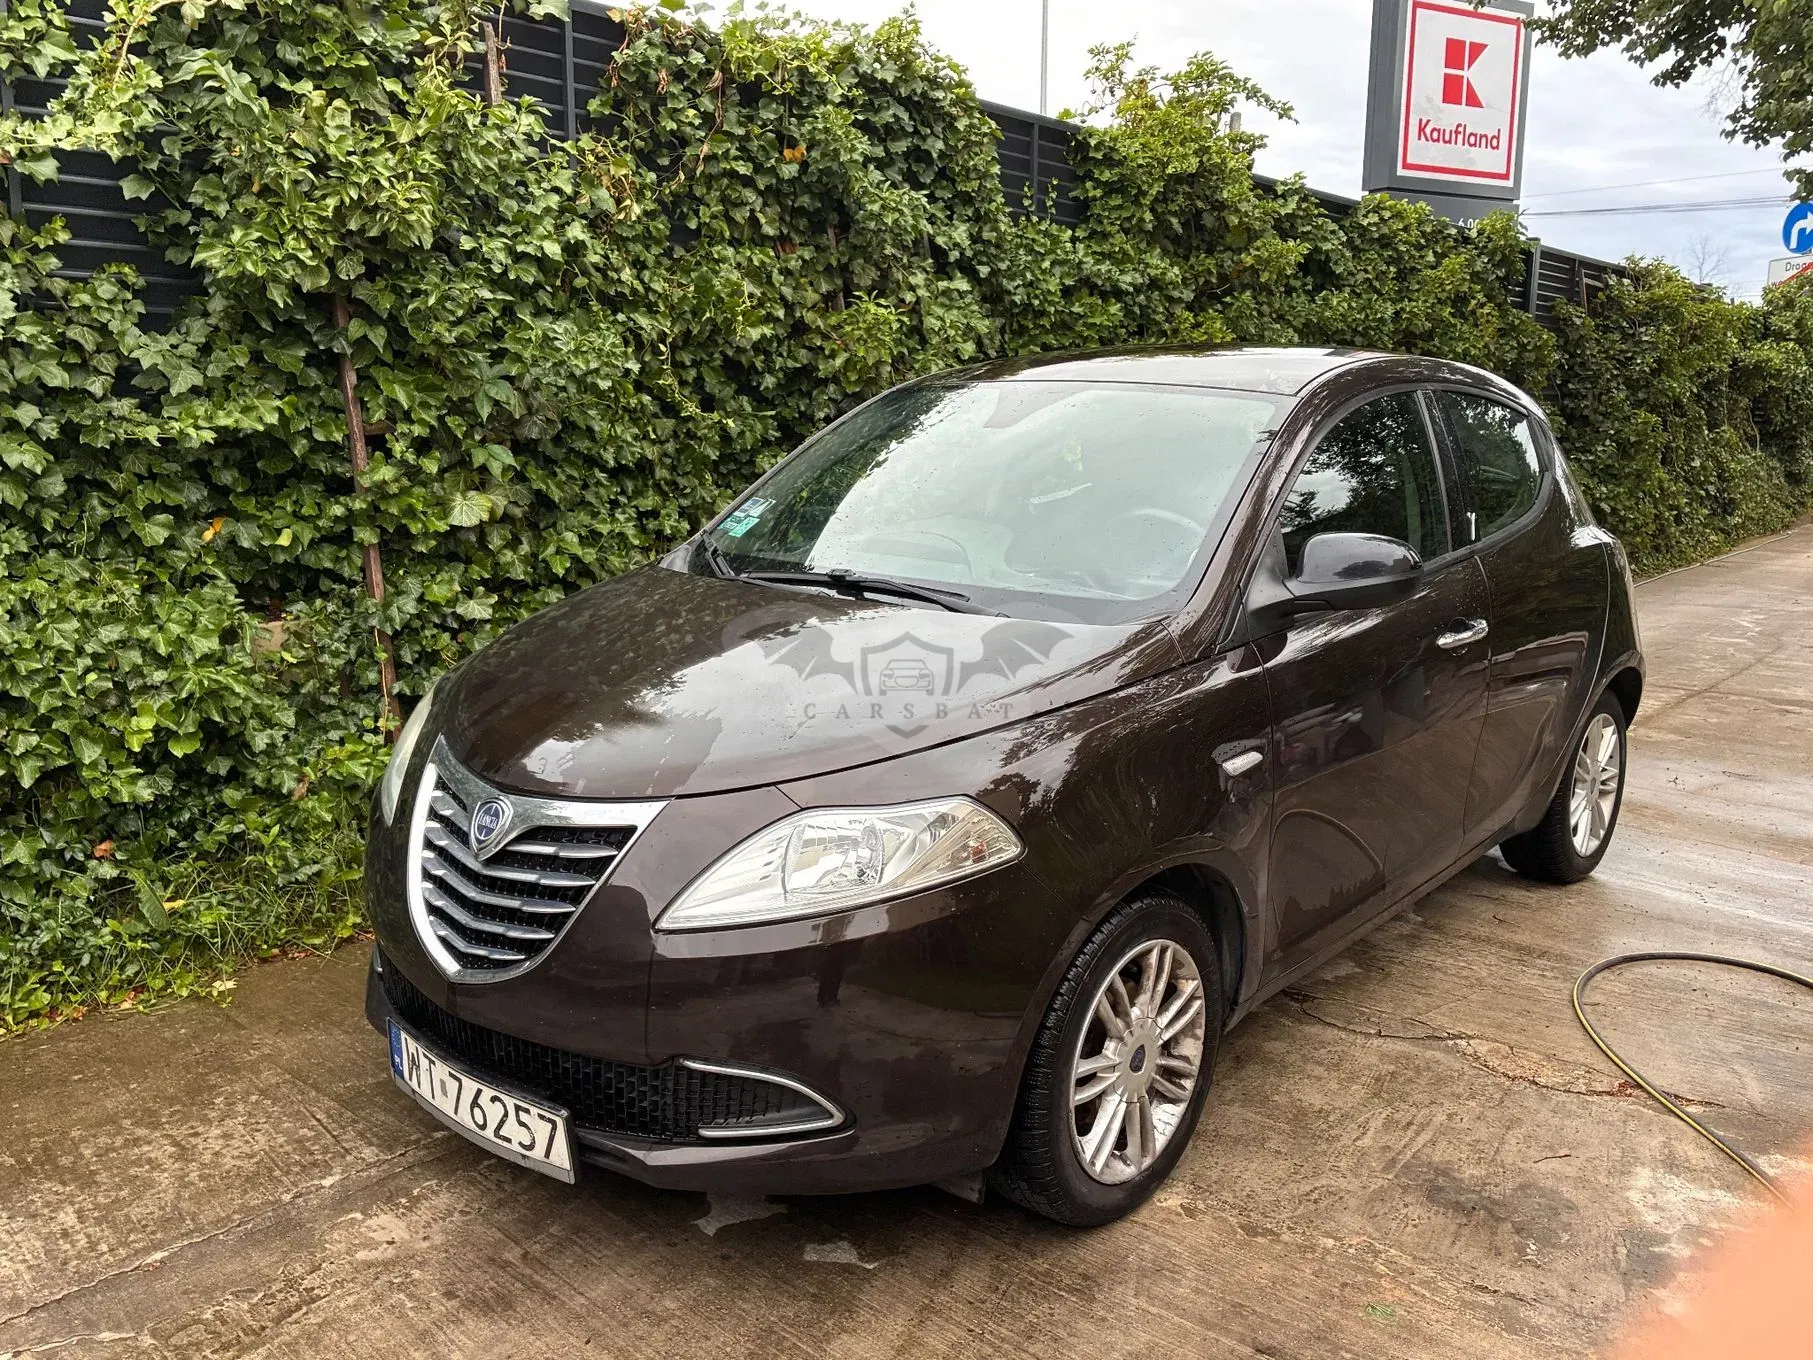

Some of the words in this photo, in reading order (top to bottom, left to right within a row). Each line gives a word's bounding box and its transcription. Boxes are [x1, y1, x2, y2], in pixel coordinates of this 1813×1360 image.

[1417, 118, 1501, 150] Kaufland
[394, 1054, 403, 1070] PL
[404, 1036, 438, 1101] WT
[448, 1070, 558, 1159] 76257
